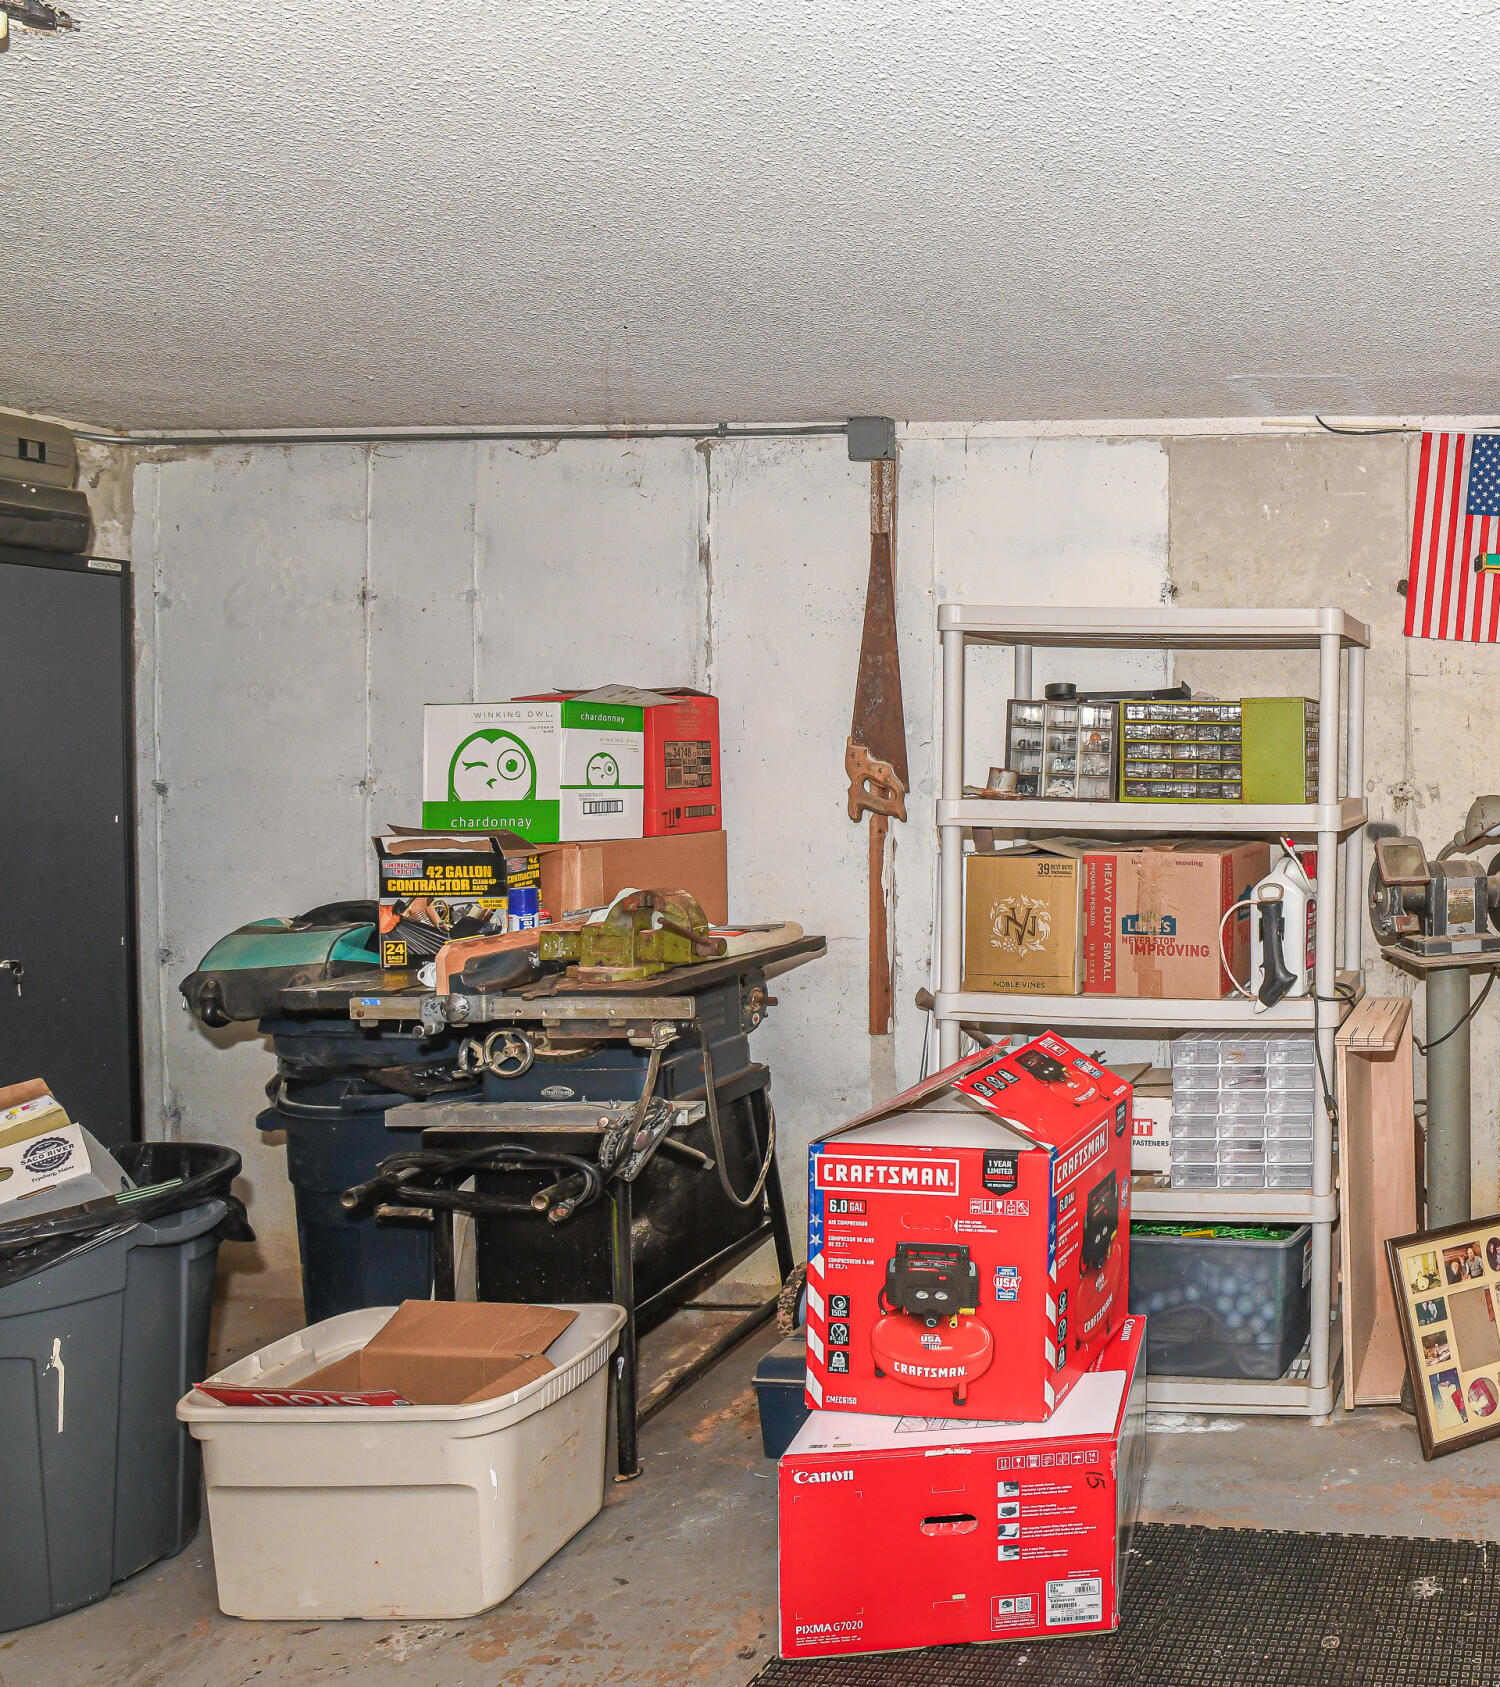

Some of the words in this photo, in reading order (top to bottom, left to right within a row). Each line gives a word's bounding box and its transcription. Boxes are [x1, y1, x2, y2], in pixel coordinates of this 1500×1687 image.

[473, 710, 522, 719] WINKING
[580, 712, 626, 724] chardonnay
[450, 816, 533, 830] chardonnay
[426, 866, 444, 879] 42
[445, 865, 493, 878] GALLON
[1037, 862, 1050, 875] 39
[387, 879, 471, 892] CONTRACTOR
[1103, 862, 1113, 903] HEAVY
[1103, 906, 1112, 939] DUTY
[1121, 936, 1152, 945] NEVER
[1153, 937, 1176, 945] STOP
[386, 944, 405, 955] 24
[1130, 944, 1210, 958] IMPROVING
[1103, 942, 1112, 982] SMALL
[993, 980, 1021, 988] NOBLE
[1022, 981, 1046, 989] VINES
[1132, 1139, 1170, 1147] FASTENERS
[20, 1152, 45, 1166] SACO
[47, 1143, 75, 1157] RIVER
[1056, 1131, 1106, 1185] CRAFTSMAN
[993, 1160, 1013, 1168] YEAR
[823, 1163, 950, 1187] CRAFTSMAN
[829, 1199, 848, 1213] 6.0
[849, 1202, 865, 1213] GAL
[995, 1277, 1018, 1288] USA
[831, 1309, 842, 1317] 150
[1120, 1318, 1136, 1342] Canon
[920, 1335, 943, 1343] USA
[893, 1361, 968, 1378] CRAFTSMAN
[793, 1470, 854, 1484] Canon
[795, 1623, 832, 1635] PIXMA
[833, 1620, 864, 1632] G7020
